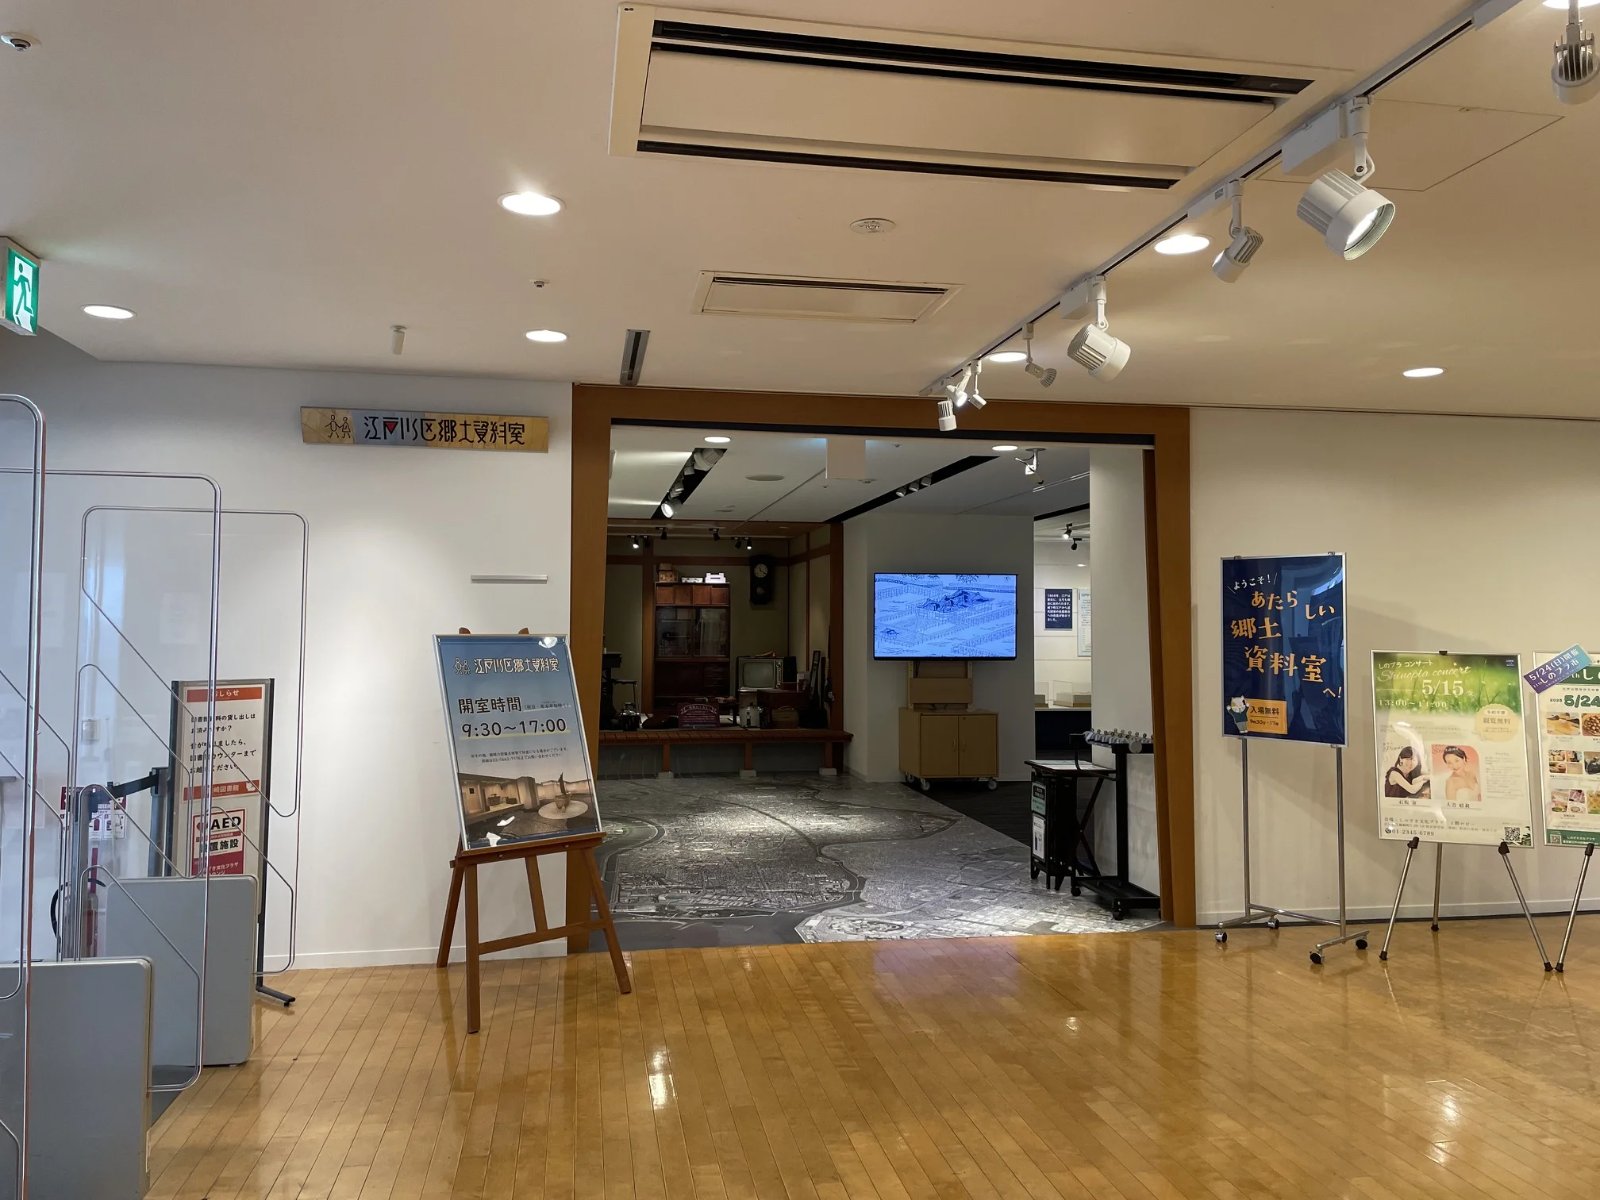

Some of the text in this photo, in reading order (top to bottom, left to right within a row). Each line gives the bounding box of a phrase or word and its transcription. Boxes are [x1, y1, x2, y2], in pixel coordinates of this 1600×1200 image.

[363, 415, 526, 446] 江戸川区郷土資料室
[1251, 590, 1336, 621] あたらしい
[1230, 616, 1282, 640] 郷土
[473, 657, 560, 674] 江戸川区郷土資料室
[1244, 645, 1327, 683] 資料室
[1421, 679, 1464, 697] 5/15
[457, 695, 522, 715] 開室時間
[211, 784, 240, 795] 崎図書館
[210, 815, 242, 831] AED
[200, 838, 239, 853] 置施設
